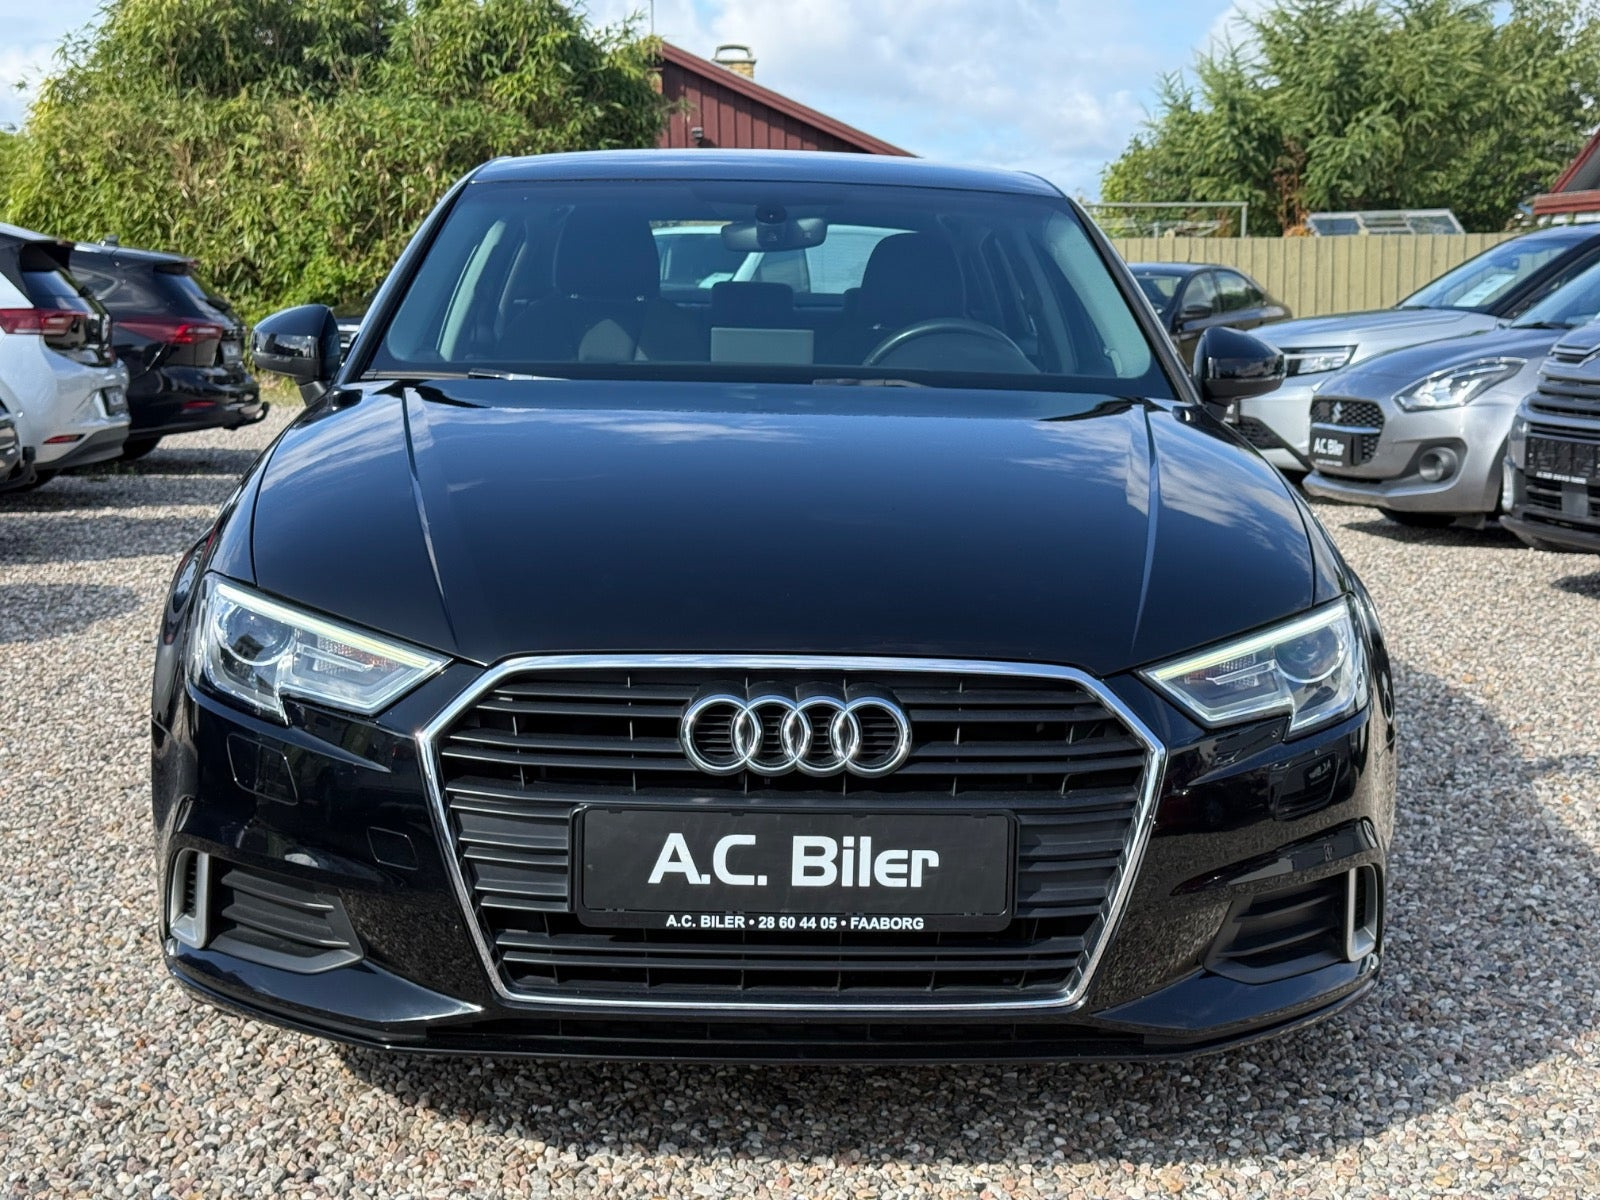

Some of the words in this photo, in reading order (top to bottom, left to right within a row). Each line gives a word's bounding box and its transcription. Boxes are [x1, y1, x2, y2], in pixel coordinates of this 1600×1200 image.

[647, 832, 768, 886] A.C.
[791, 835, 940, 888] Biler
[665, 914, 697, 928] A.C.
[700, 914, 746, 929] BILER
[757, 915, 776, 929] 28
[778, 916, 796, 930] 60
[798, 916, 817, 930] 44
[819, 916, 838, 930] 05
[850, 916, 925, 931] FAABORG
